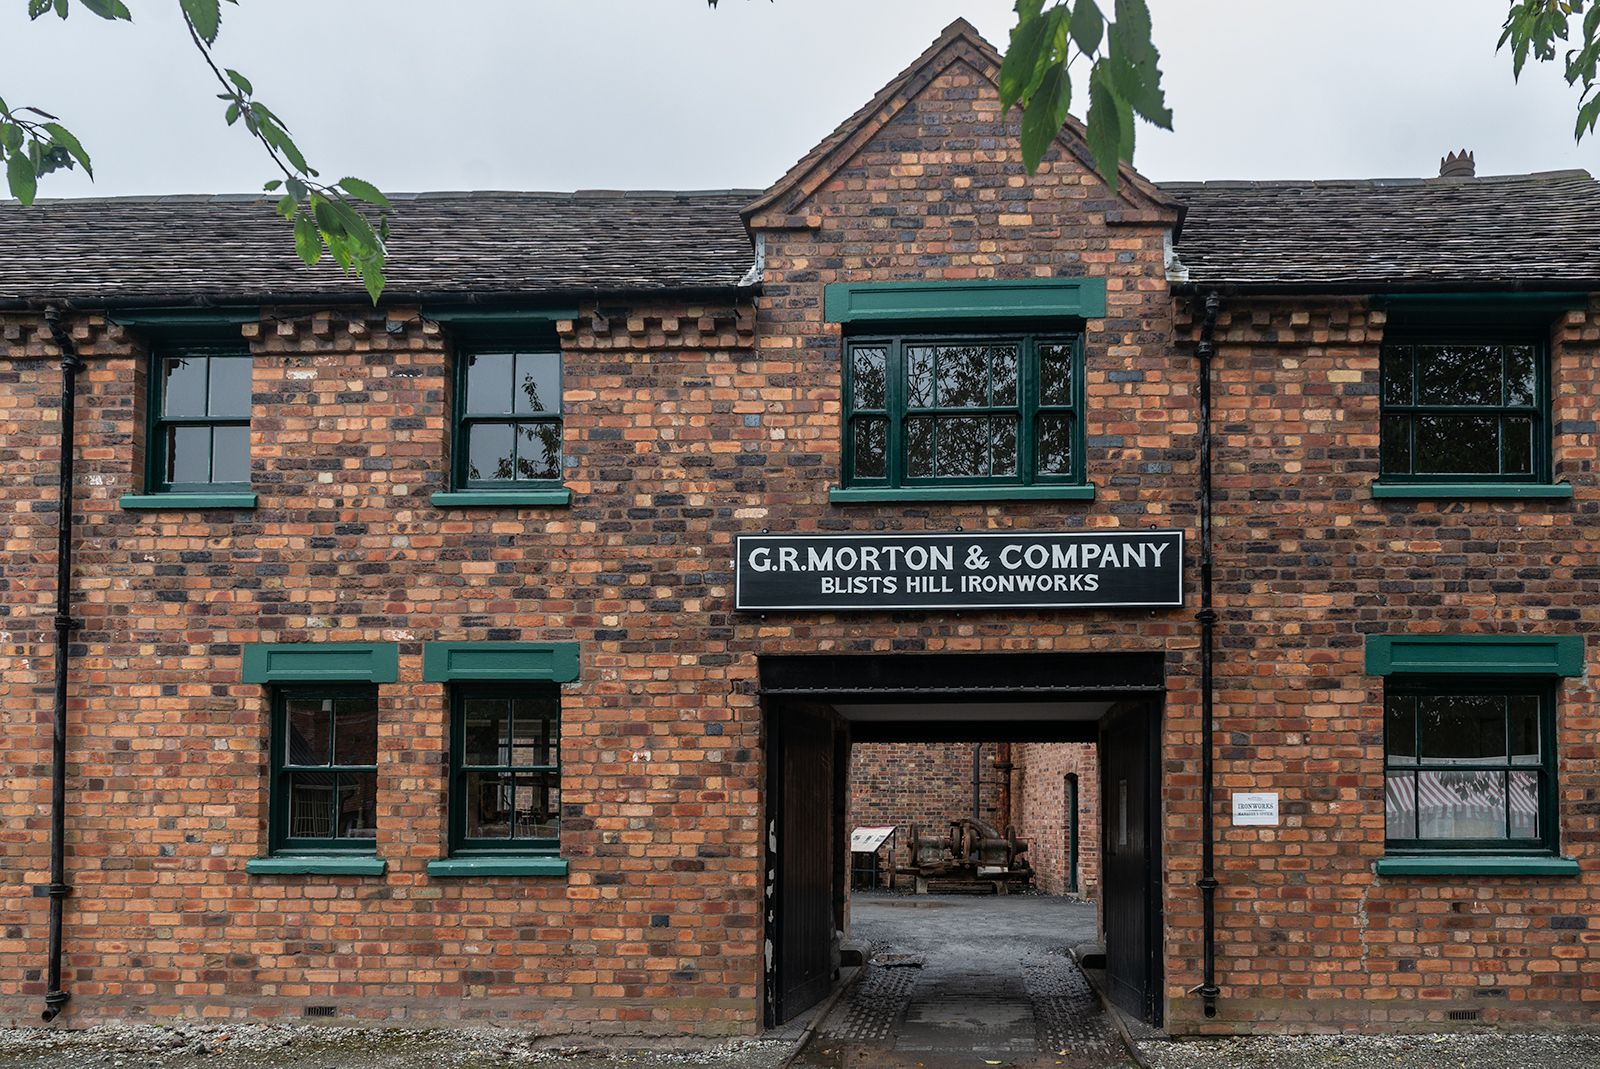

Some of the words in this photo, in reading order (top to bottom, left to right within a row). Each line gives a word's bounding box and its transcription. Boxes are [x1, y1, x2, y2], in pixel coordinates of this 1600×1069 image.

[963, 544, 991, 571] &
[999, 543, 1170, 570] COMPANY
[821, 576, 898, 594] BLISTS
[906, 576, 954, 593] HILL
[961, 574, 1099, 593] IRONWORKS
